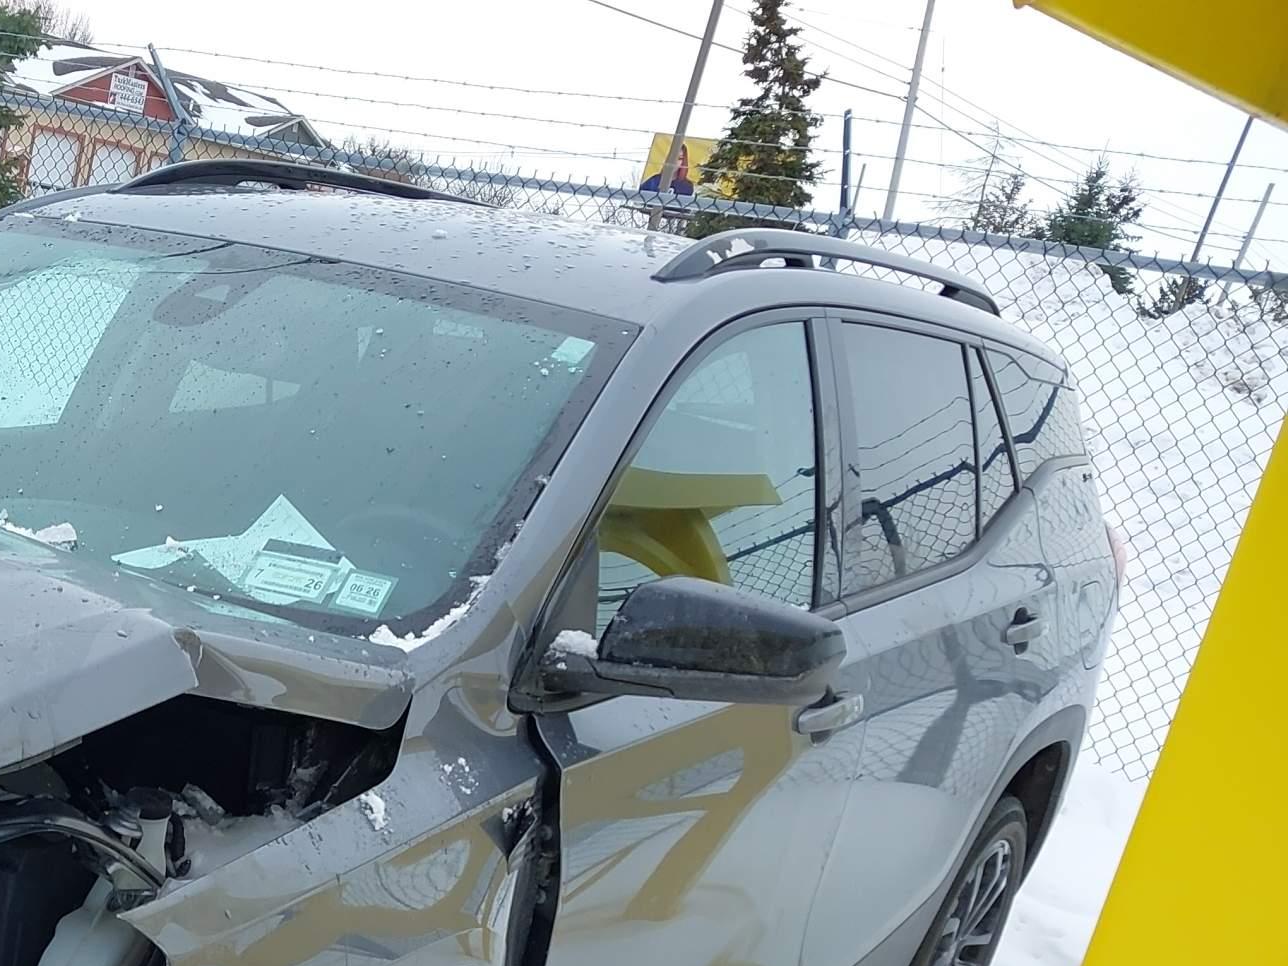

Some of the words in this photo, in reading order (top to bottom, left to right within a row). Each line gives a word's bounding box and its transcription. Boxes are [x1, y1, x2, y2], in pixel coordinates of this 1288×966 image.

[254, 568, 265, 579] 7
[304, 578, 323, 591] 26
[366, 587, 381, 597] 26
